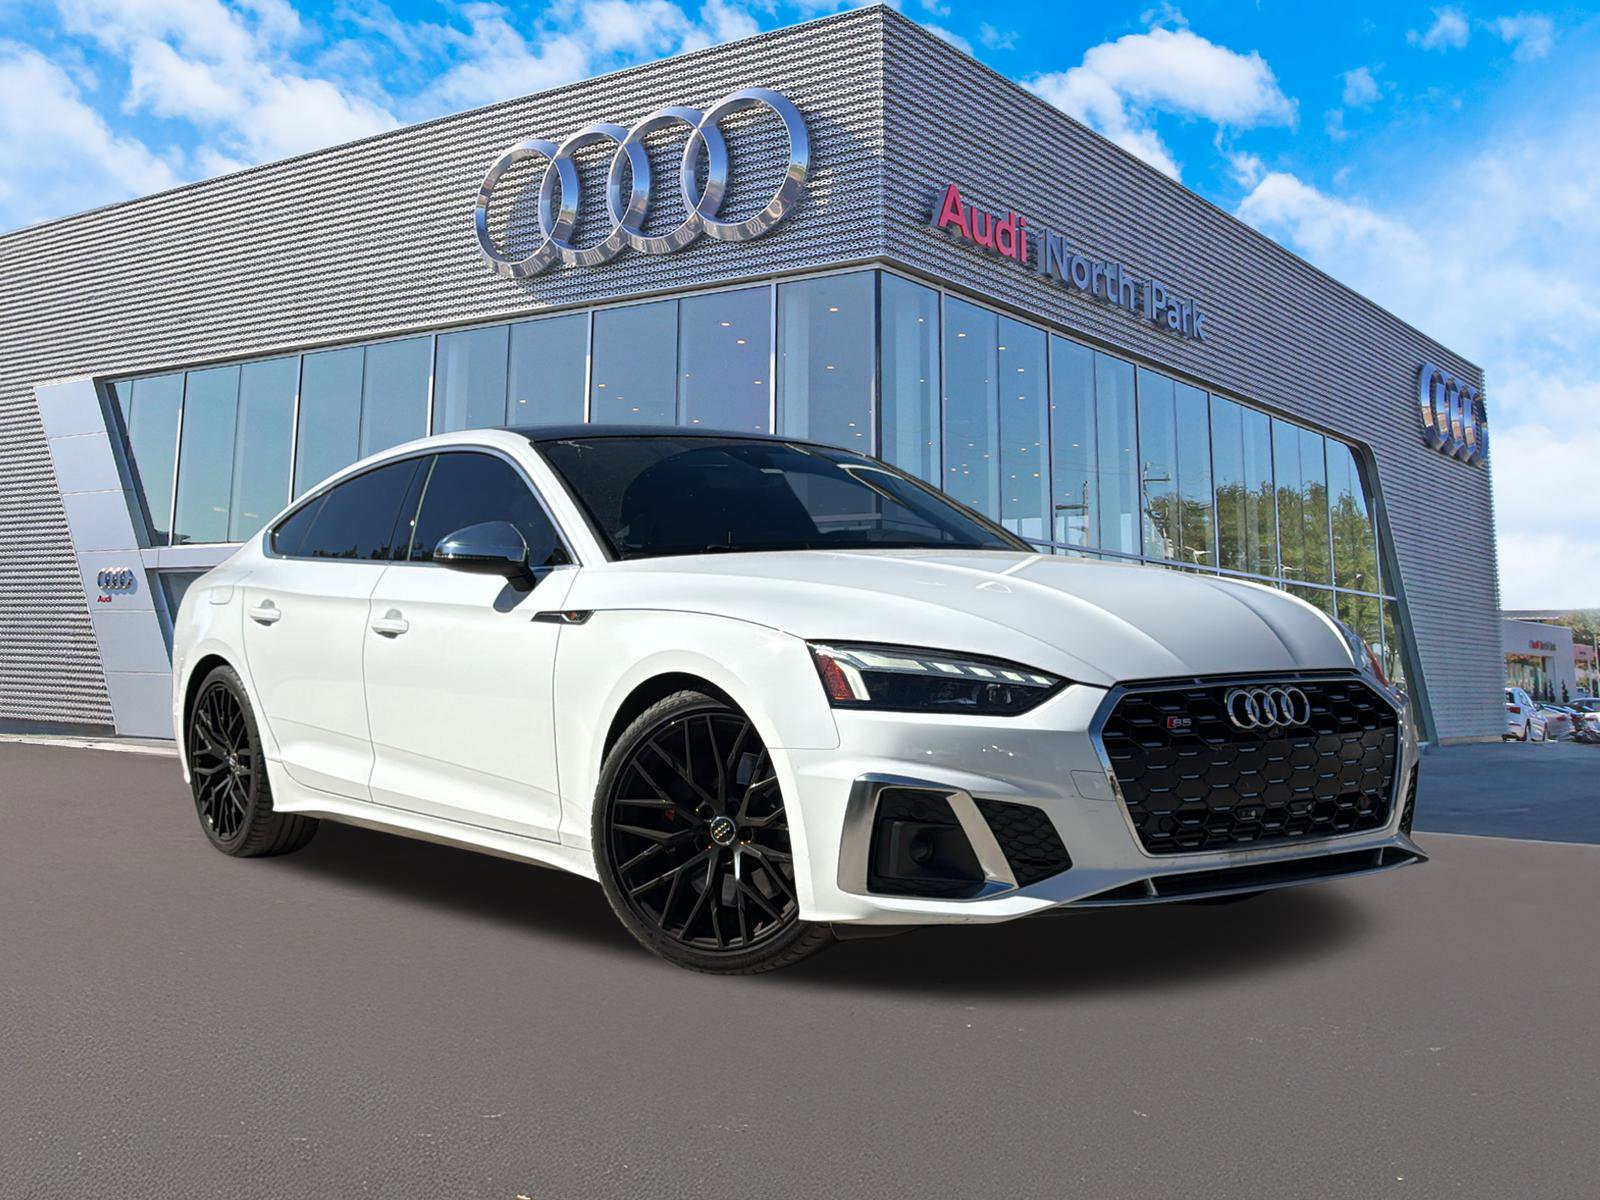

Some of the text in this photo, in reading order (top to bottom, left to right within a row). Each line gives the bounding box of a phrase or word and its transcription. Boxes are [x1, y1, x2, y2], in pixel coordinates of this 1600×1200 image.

[934, 184, 1206, 339] Audi North Park
